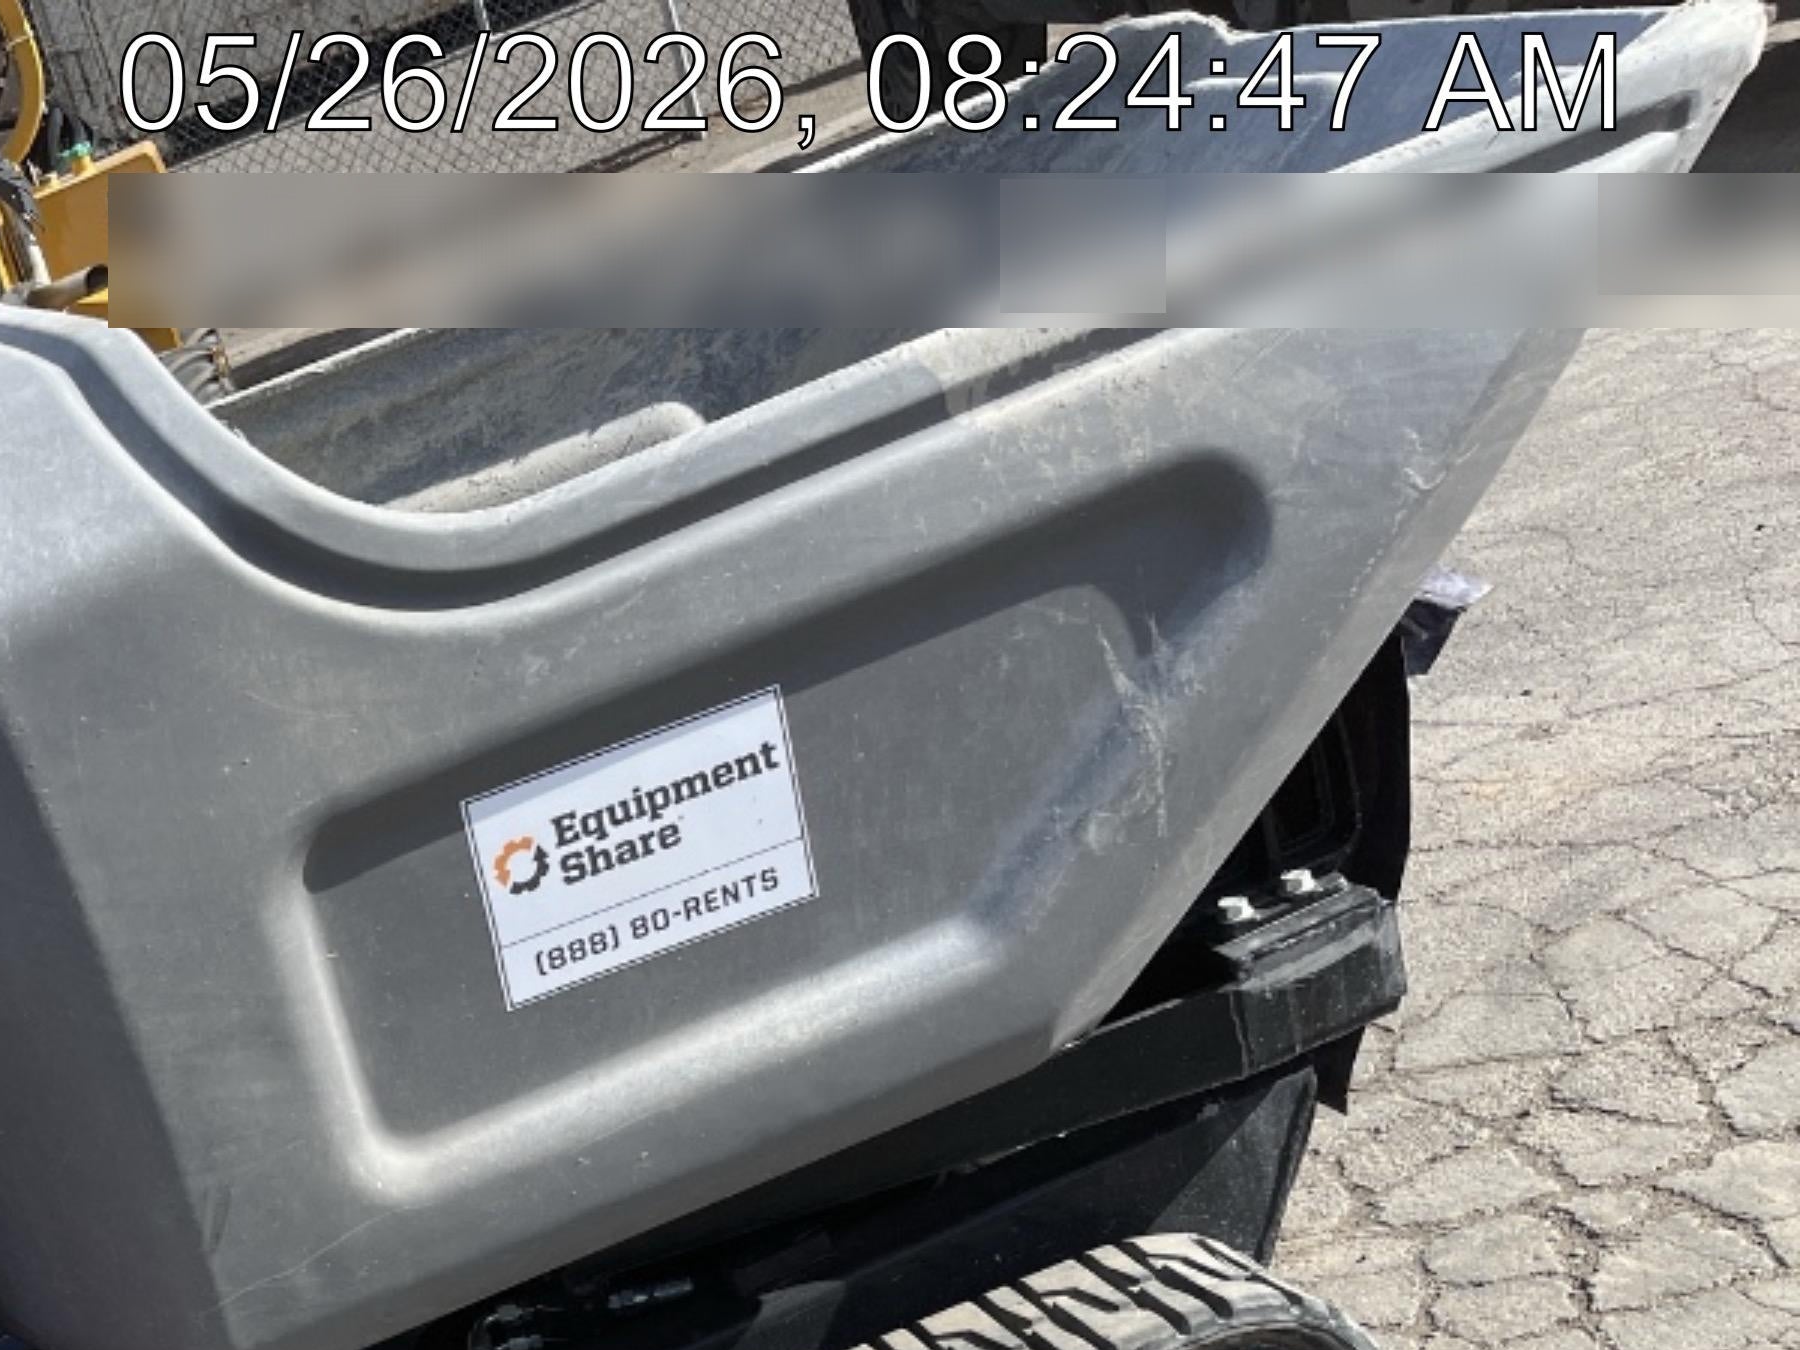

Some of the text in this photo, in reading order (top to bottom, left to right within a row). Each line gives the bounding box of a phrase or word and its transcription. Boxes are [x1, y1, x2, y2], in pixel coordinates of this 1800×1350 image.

[550, 740, 781, 850] Equipment
[559, 822, 682, 886] Share
[535, 866, 780, 977] (888) 80-RENTS
